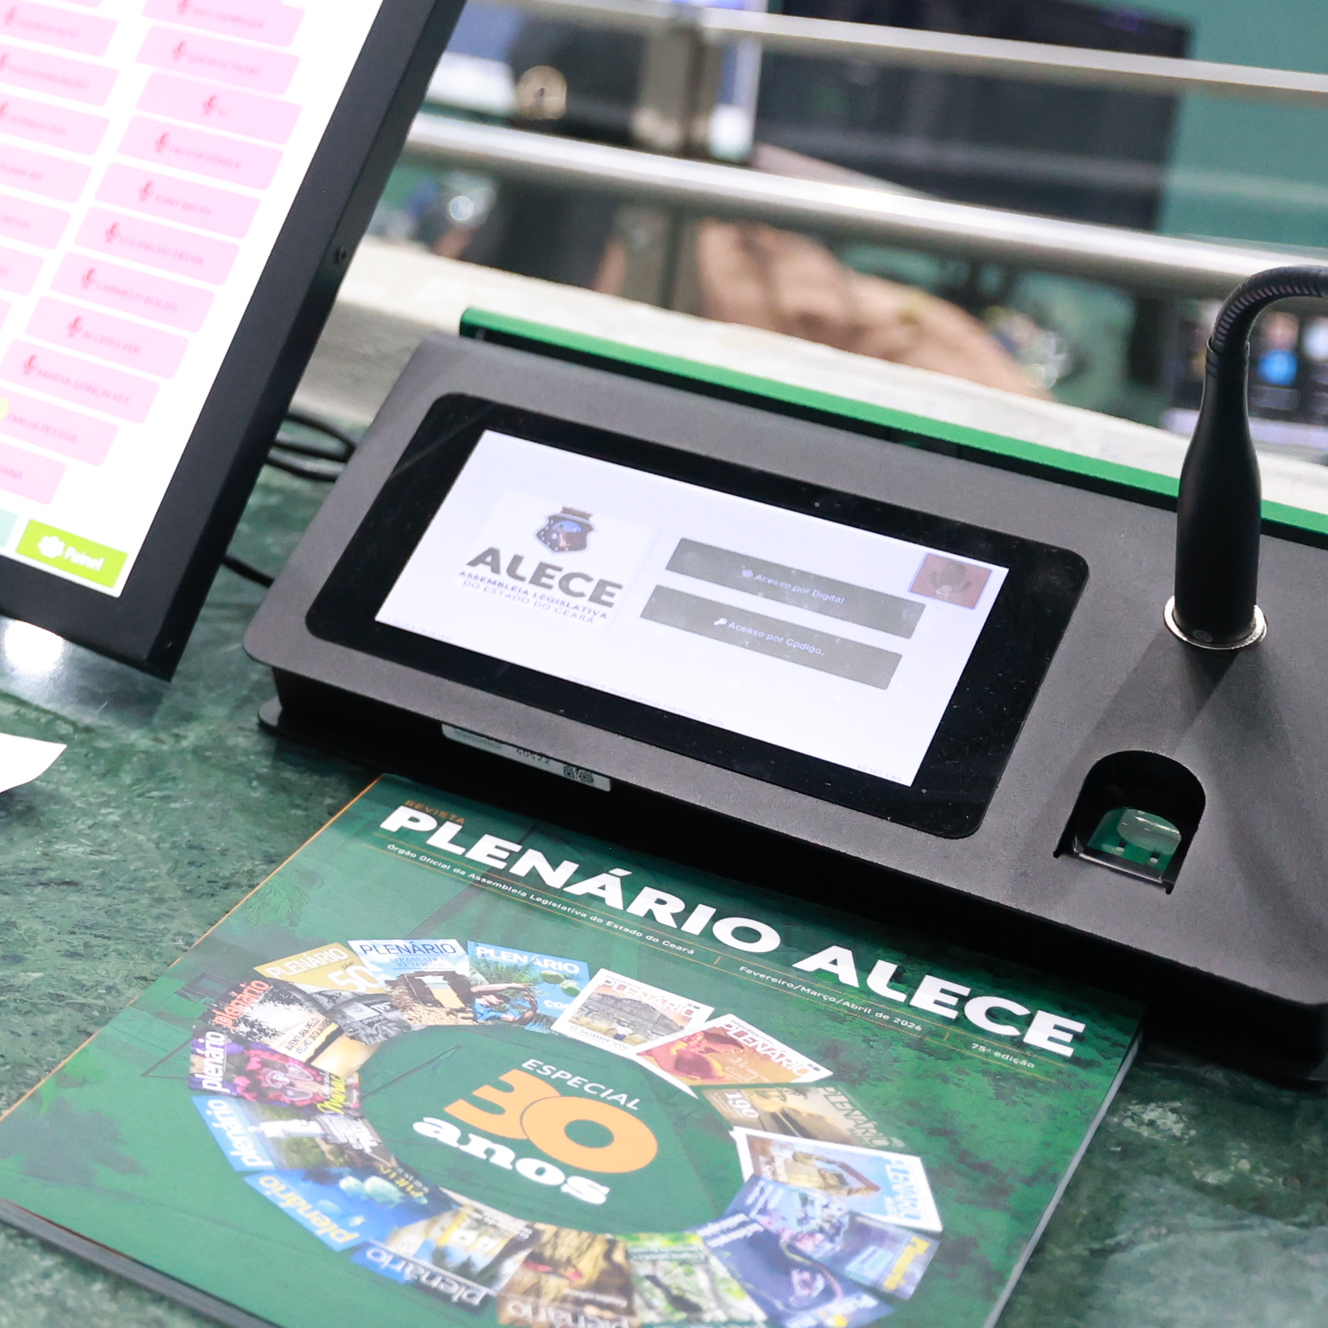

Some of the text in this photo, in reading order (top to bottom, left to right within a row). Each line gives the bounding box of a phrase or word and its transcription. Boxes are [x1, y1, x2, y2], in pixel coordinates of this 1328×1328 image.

[458, 571, 608, 620] ASSEMBLEIA LEGISLATIVA
[462, 580, 481, 589] DO
[482, 586, 531, 605] ESTADO
[533, 600, 551, 611] DO
[466, 547, 623, 608] ALECE
[754, 573, 846, 605] Acesso por Digital
[728, 622, 766, 639] Acesso
[765, 633, 784, 645] por
[405, 799, 465, 824] REVISTA
[418, 852, 451, 870] Oficial
[453, 865, 466, 876] da
[467, 870, 527, 897] Assembleia
[529, 892, 587, 919] Legislativa
[589, 914, 604, 924] do
[606, 920, 643, 937] Estado
[644, 933, 659, 944] do
[661, 938, 696, 956] Ceará
[359, 940, 457, 955] PLENÁRIO
[379, 805, 1086, 1057] PLENÁRIO ALECE
[264, 947, 349, 979] PLENÁRIO
[874, 1009, 891, 1021] de
[893, 1016, 923, 1032] 2026
[194, 1031, 231, 1093] plenário
[994, 1048, 1036, 1069] edição
[521, 1058, 641, 1111] ESPECIAL
[724, 1091, 760, 1119] 190
[207, 1099, 274, 1167] plenário
[444, 1069, 658, 1173] 30
[412, 1117, 610, 1205] anos
[259, 1175, 360, 1244] plenário
[365, 1247, 485, 1308] plenário
